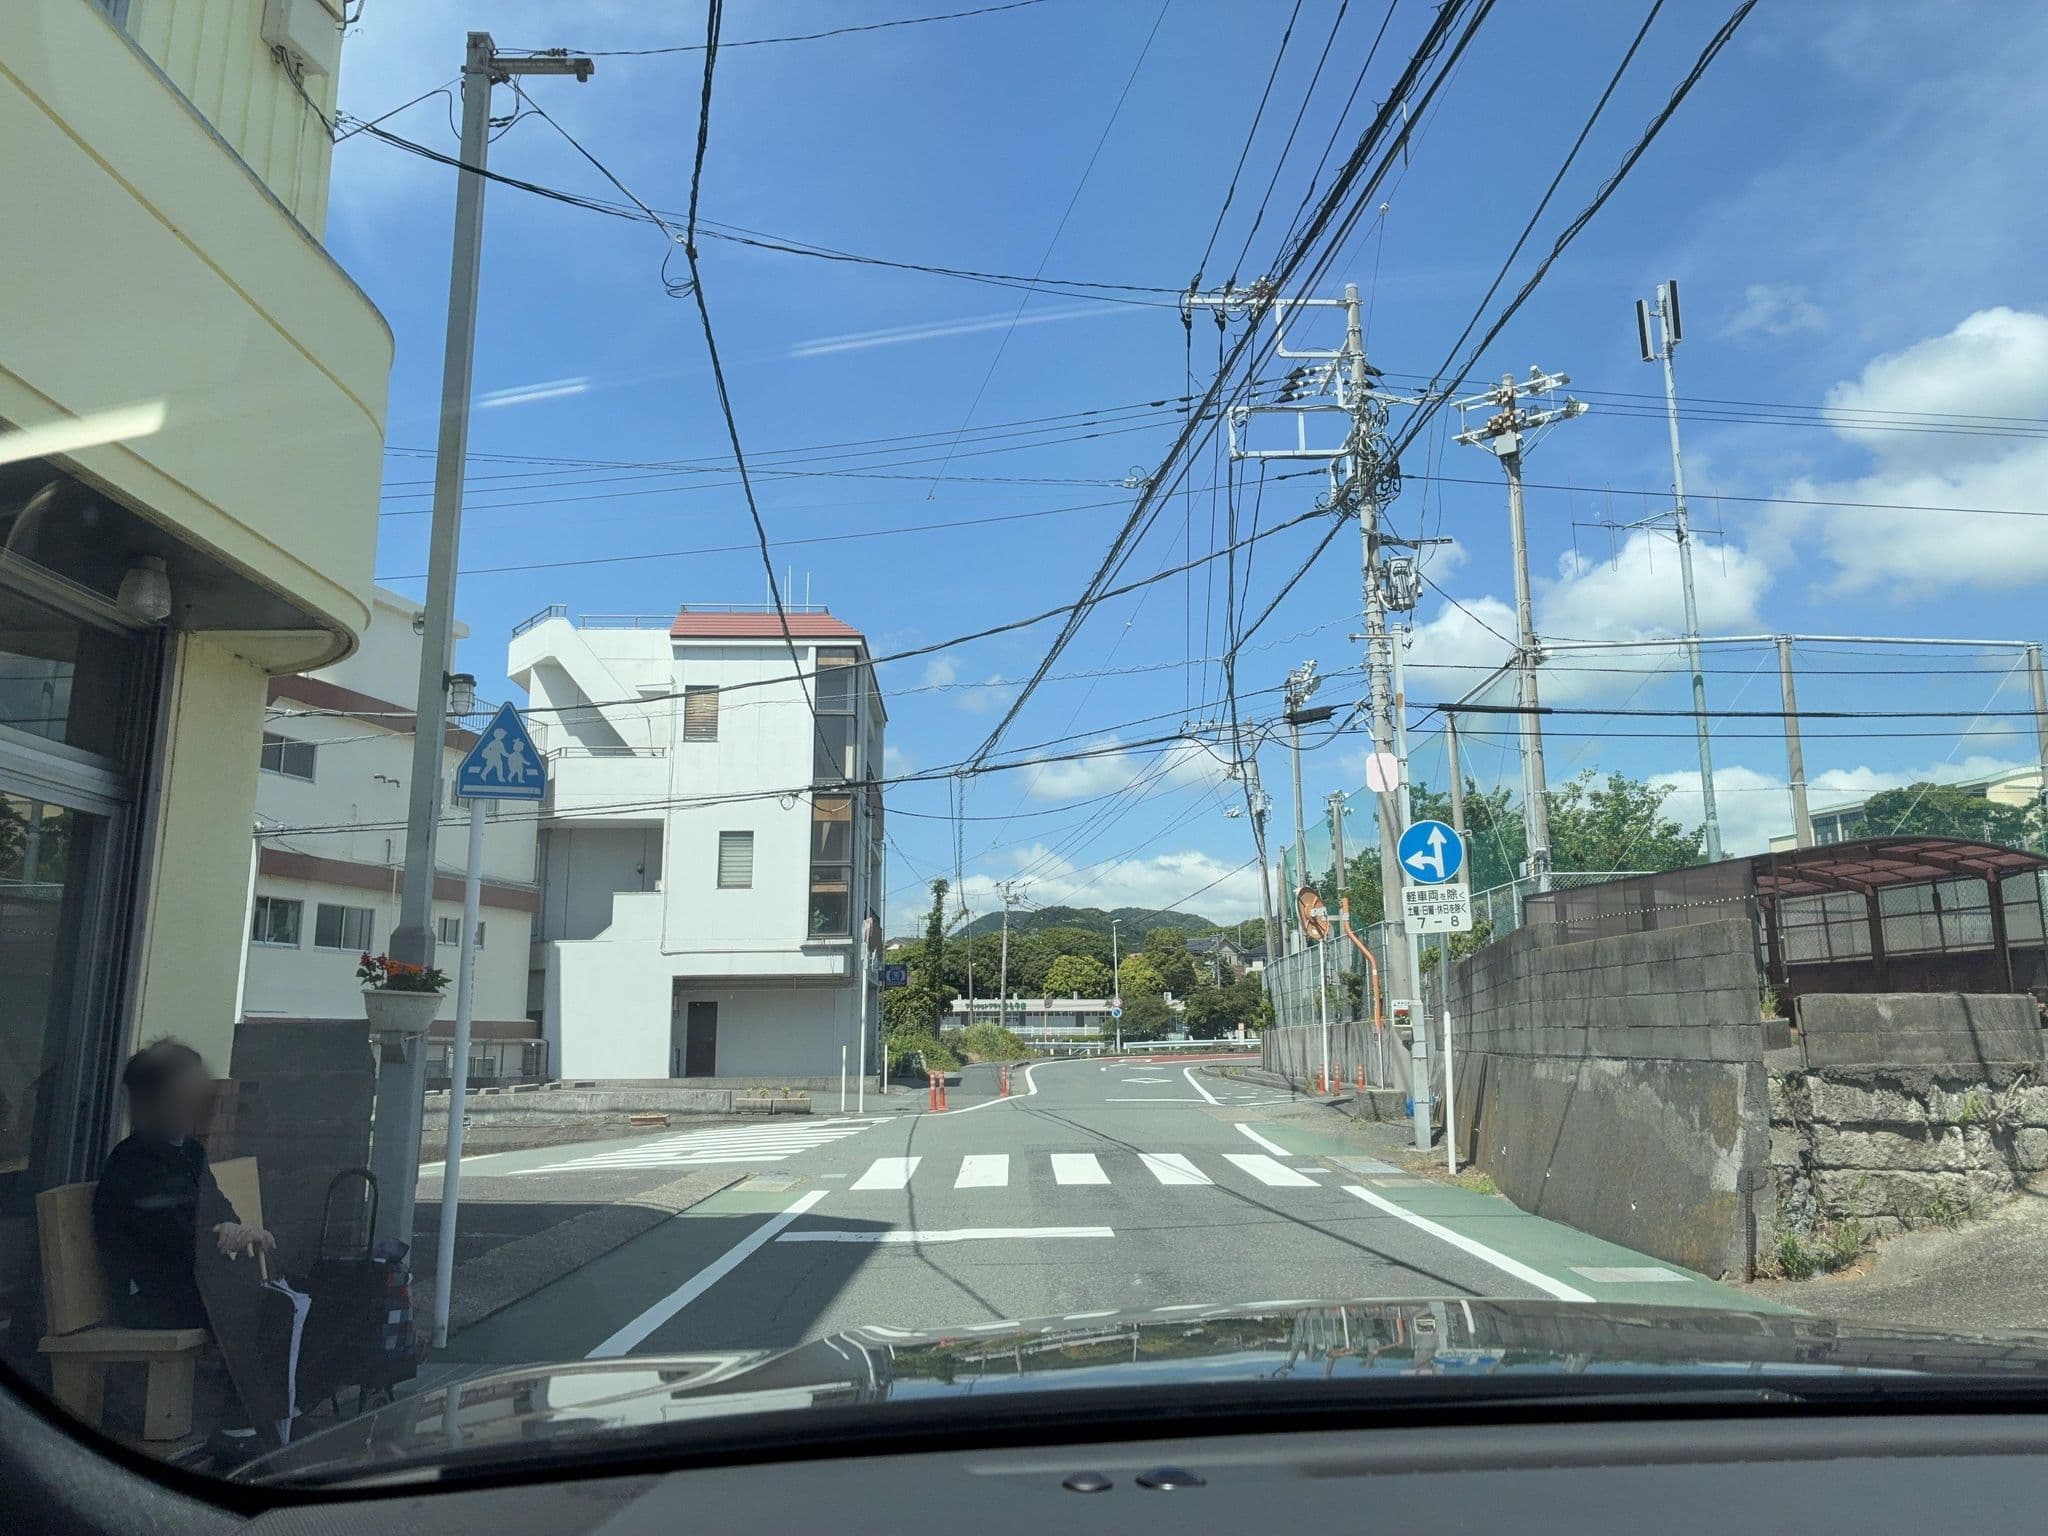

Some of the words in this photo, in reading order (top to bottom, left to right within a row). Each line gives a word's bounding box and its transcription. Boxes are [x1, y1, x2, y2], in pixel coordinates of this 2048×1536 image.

[1406, 889, 1465, 902] 軽車両を除く
